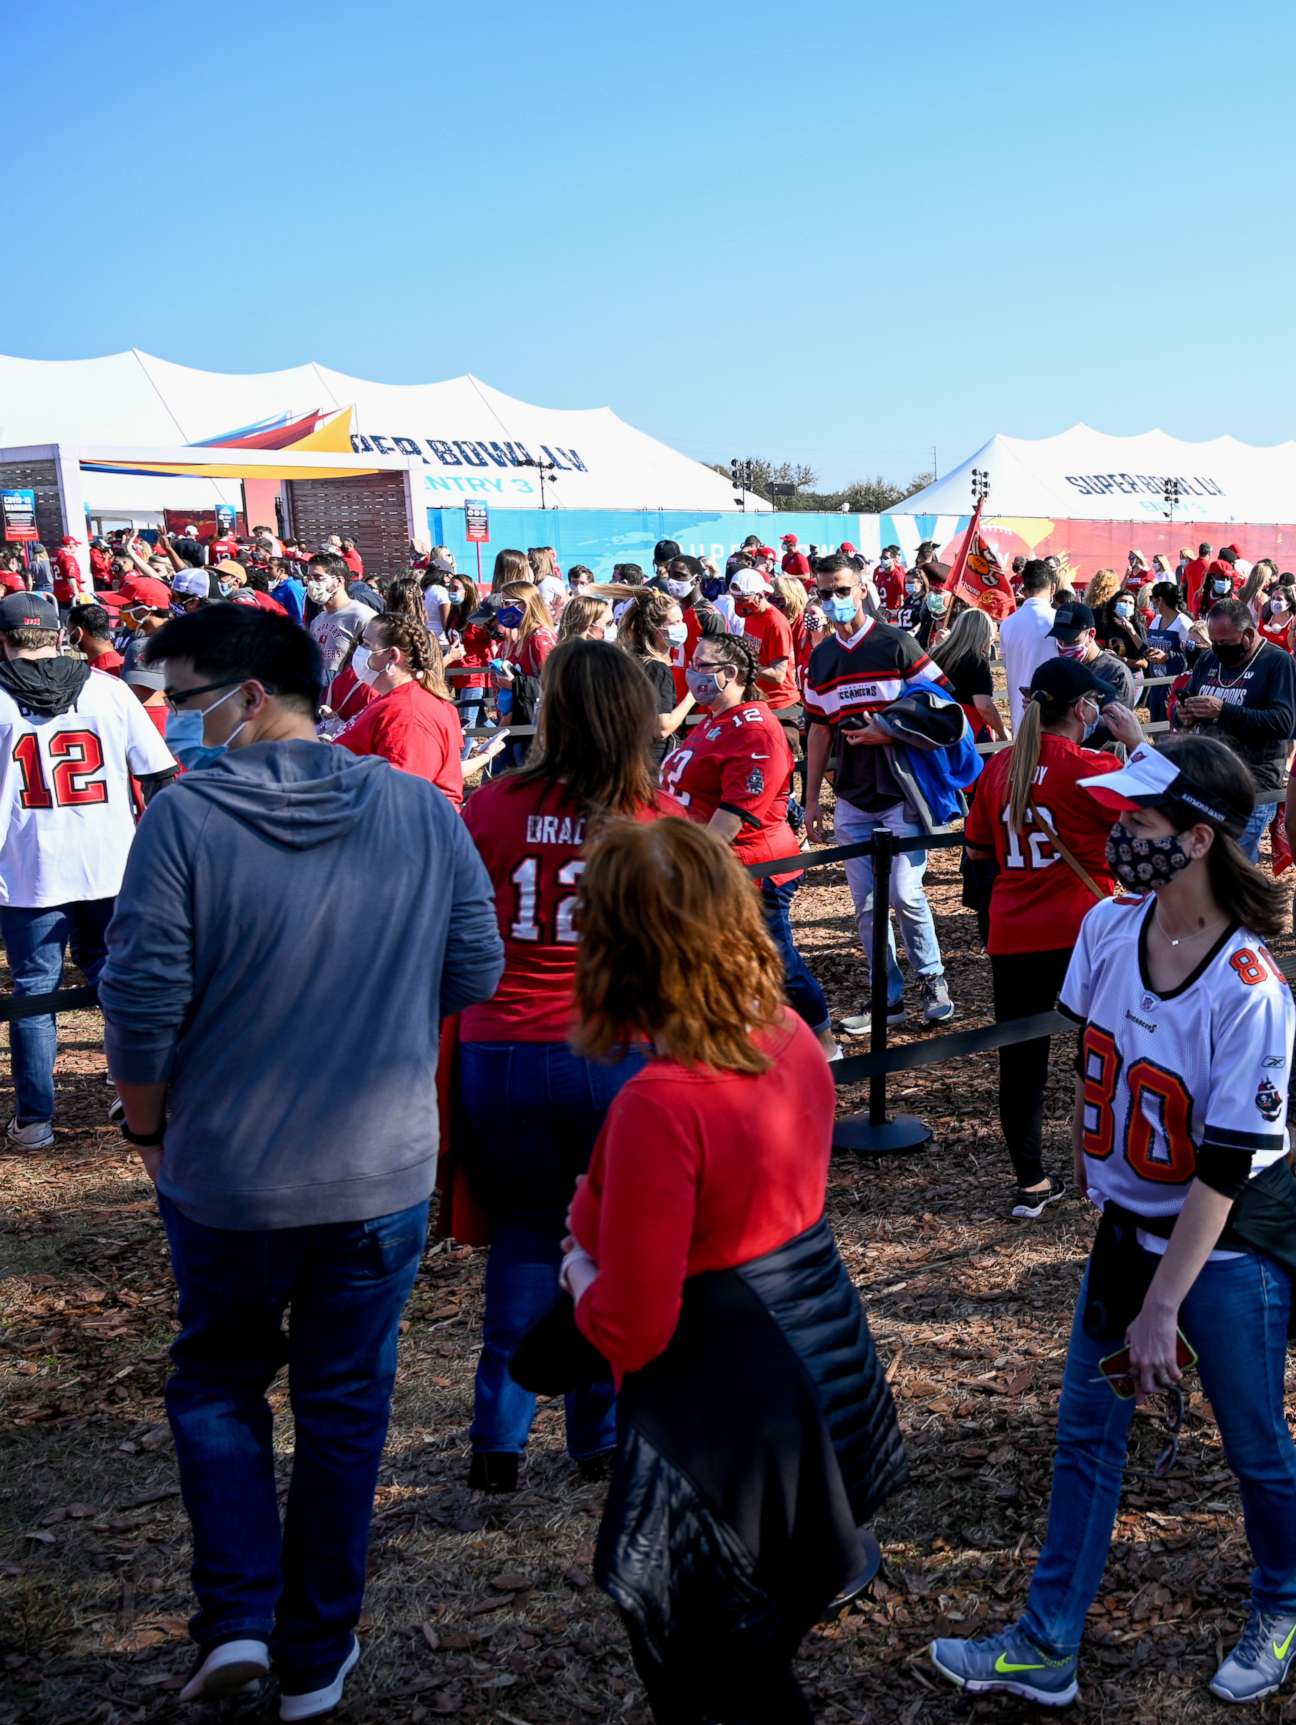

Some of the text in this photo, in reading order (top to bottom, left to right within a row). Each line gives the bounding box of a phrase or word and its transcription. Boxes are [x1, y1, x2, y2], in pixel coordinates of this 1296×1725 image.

[424, 439, 533, 467] BOWL
[539, 445, 588, 472] LV
[424, 475, 535, 494] NTRY 3
[1065, 473, 1145, 495] SUPER
[1199, 685, 1248, 706] CHAMPIONS
[731, 707, 764, 728] 12
[12, 728, 109, 809] 12
[526, 815, 587, 845] BRAD
[1002, 803, 1062, 869] 12
[510, 857, 587, 943] 12
[1083, 1020, 1200, 1185] 80
